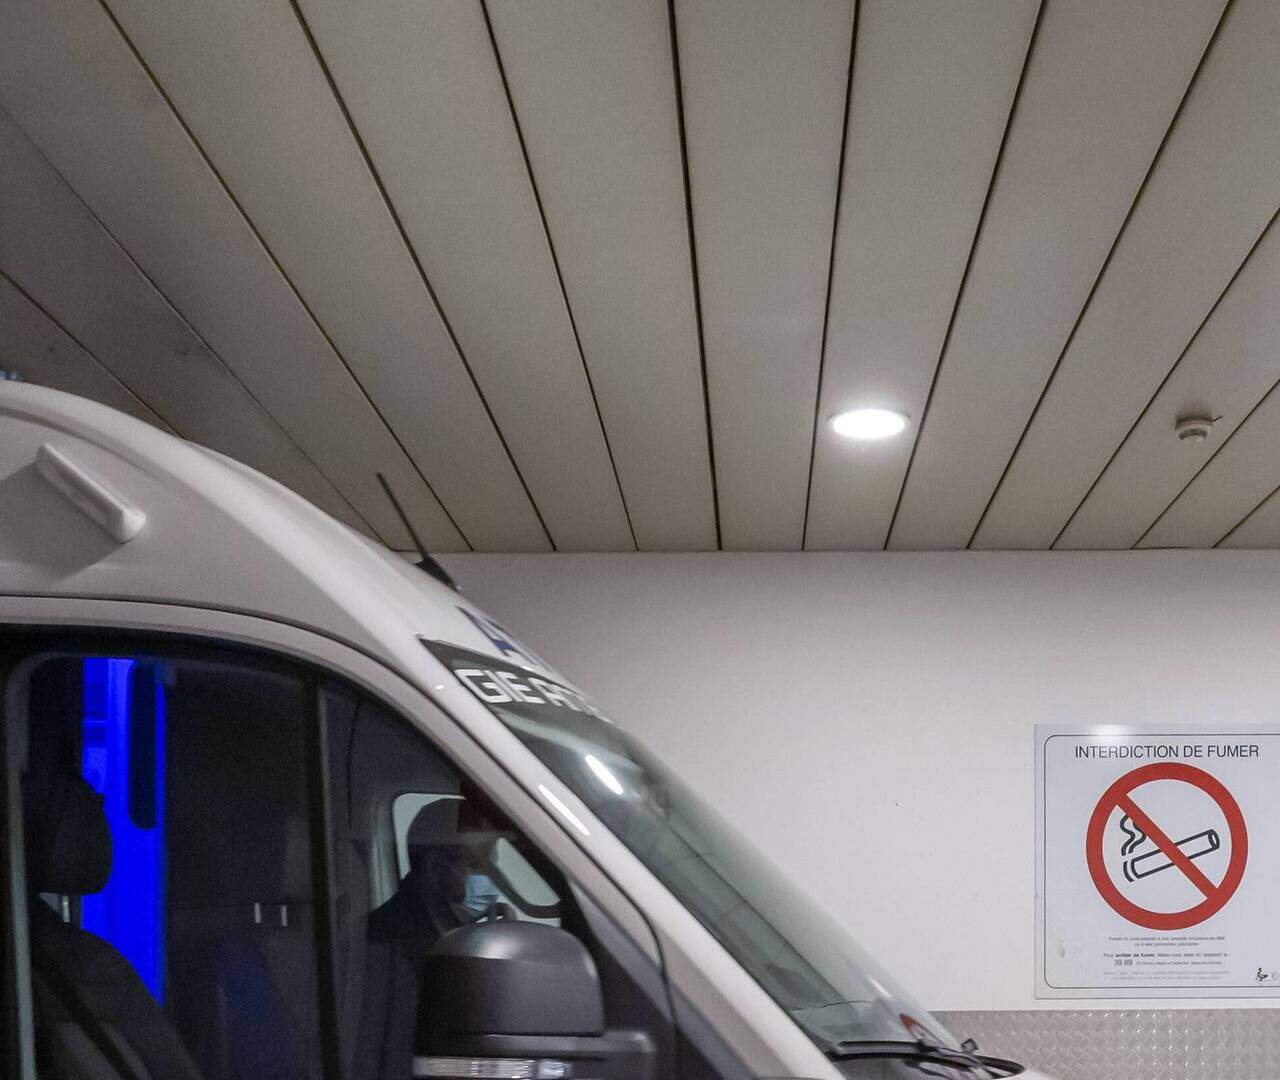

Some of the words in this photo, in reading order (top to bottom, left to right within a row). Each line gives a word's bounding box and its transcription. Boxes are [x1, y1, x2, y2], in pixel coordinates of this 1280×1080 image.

[1075, 744, 1179, 759] INTERDICTION
[1183, 744, 1203, 758] DE
[1207, 744, 1260, 758] FUMER
